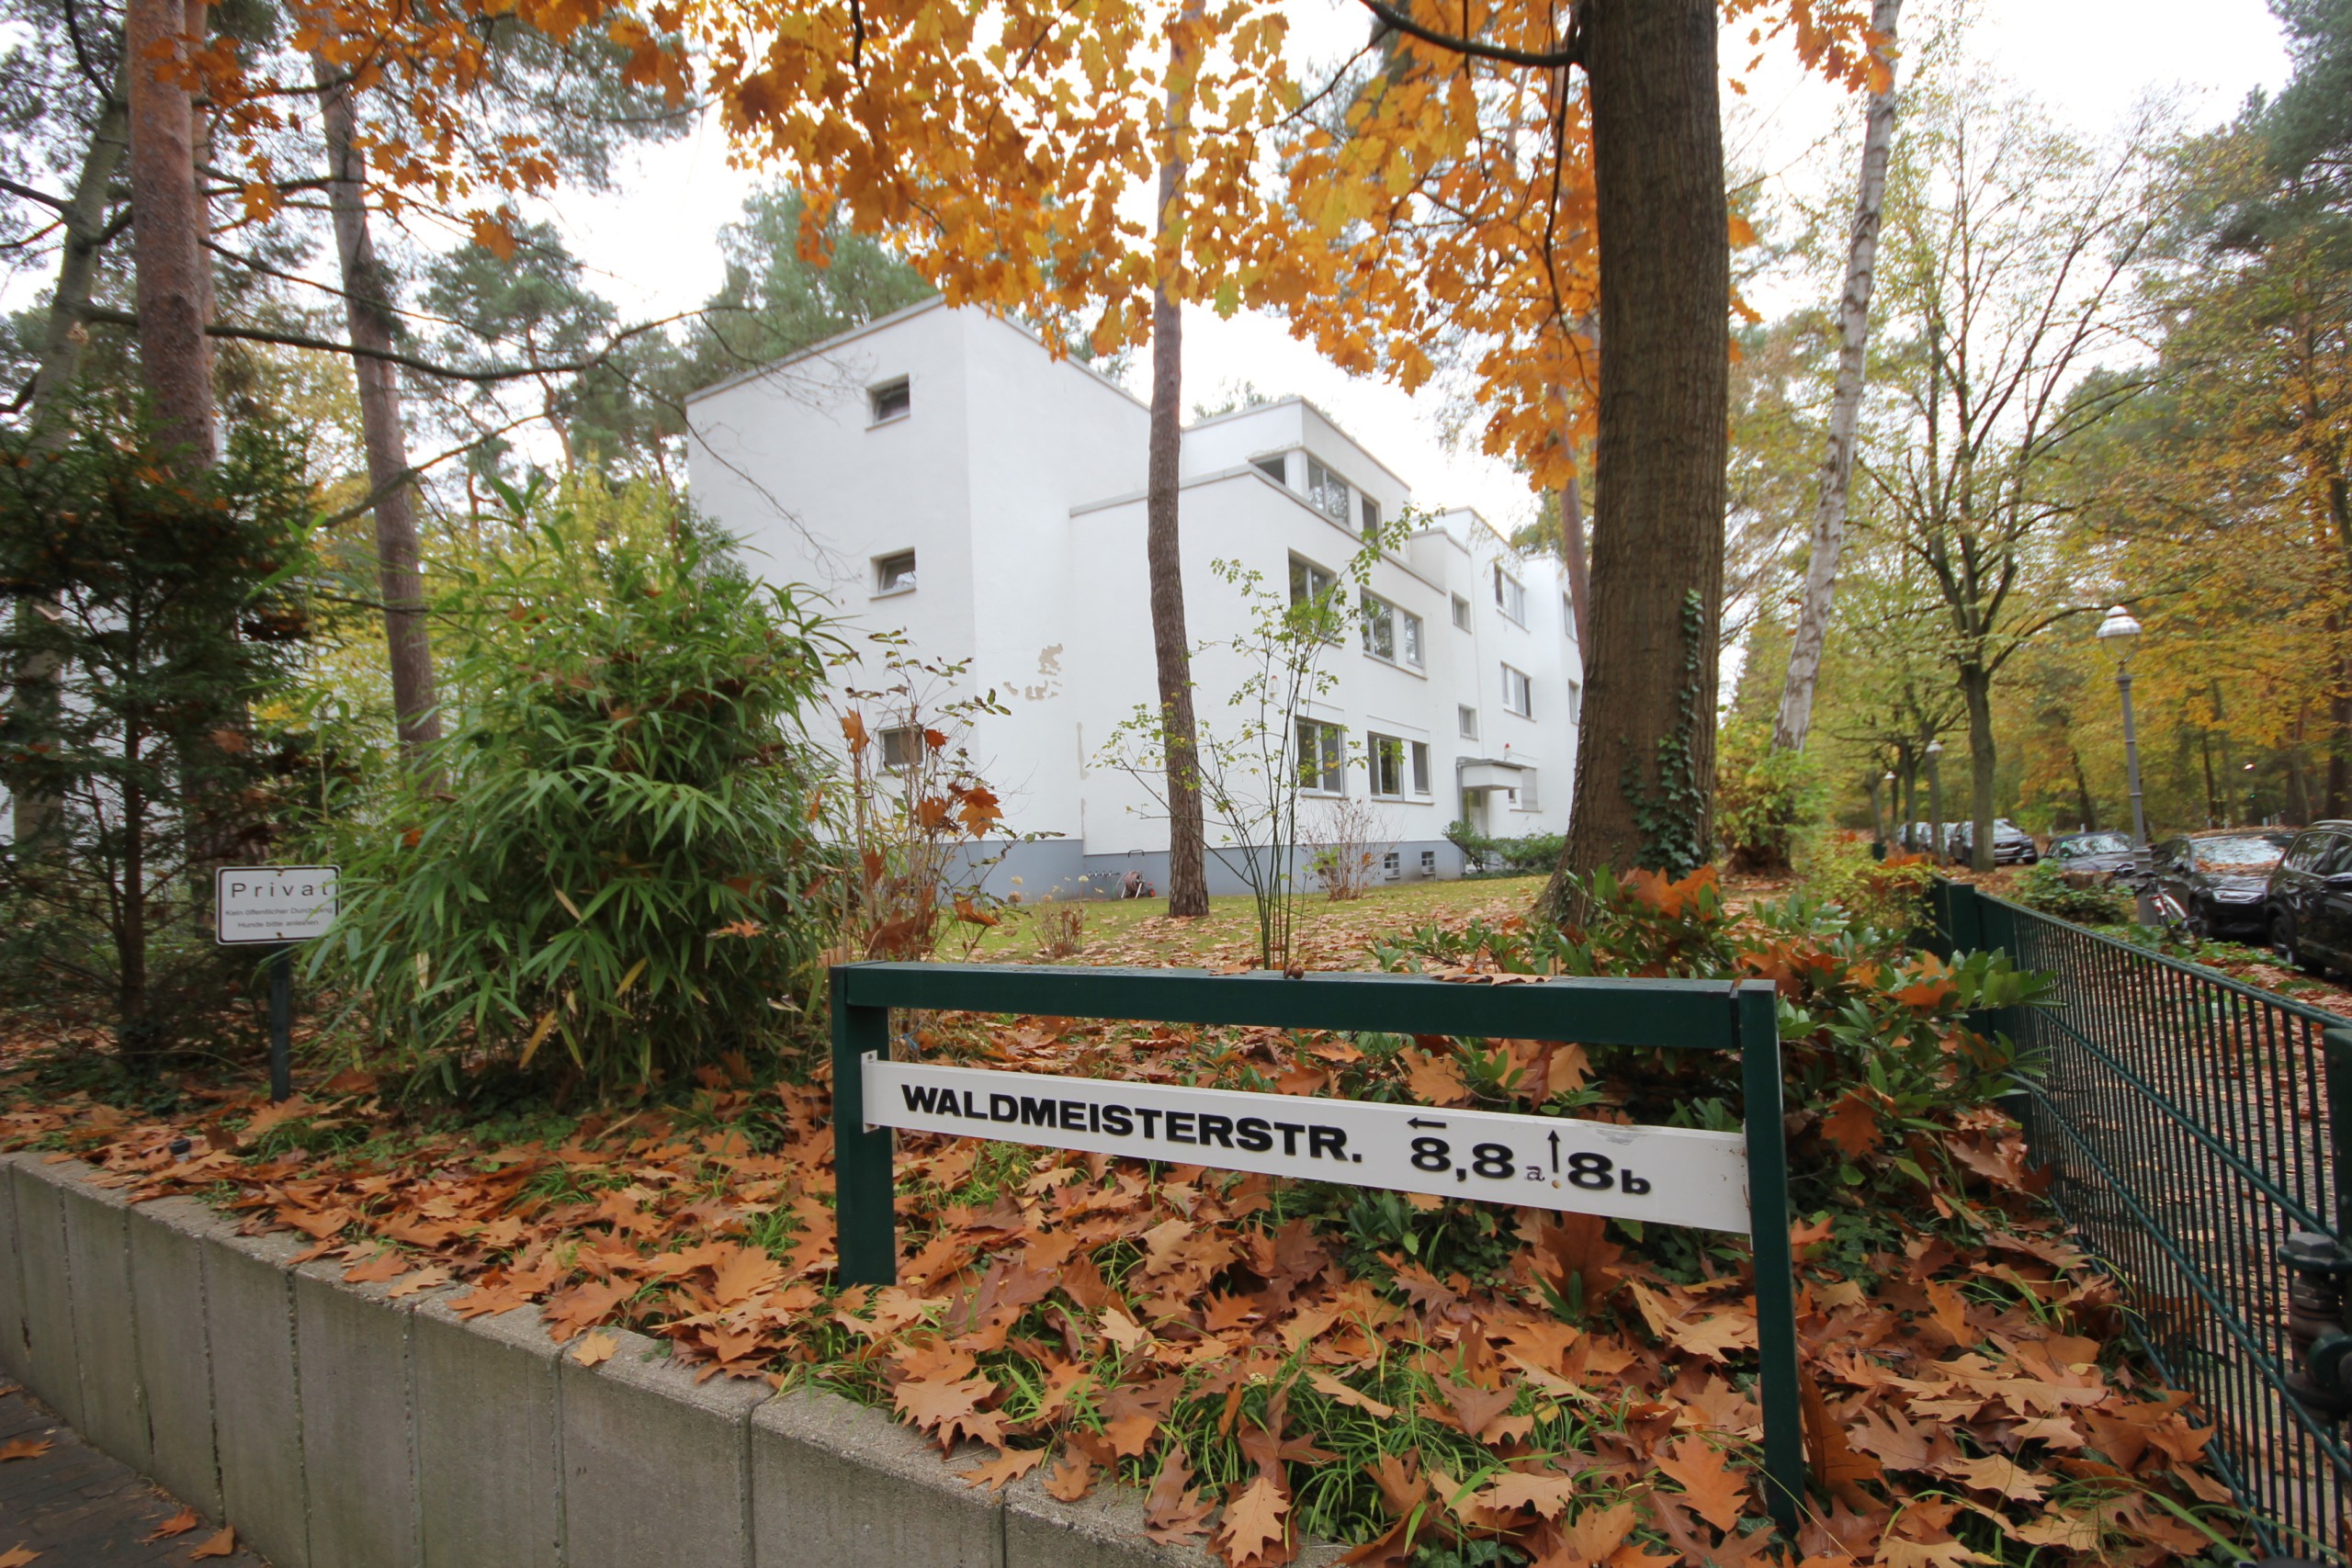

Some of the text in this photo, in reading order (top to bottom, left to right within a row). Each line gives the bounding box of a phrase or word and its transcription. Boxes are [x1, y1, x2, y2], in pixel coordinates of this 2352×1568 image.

[231, 881, 329, 898] Privat
[290, 907, 333, 916] Durchang
[900, 1084, 1363, 1164] WALDMEISTERSTR.
[1566, 1151, 1652, 1196] 8b
